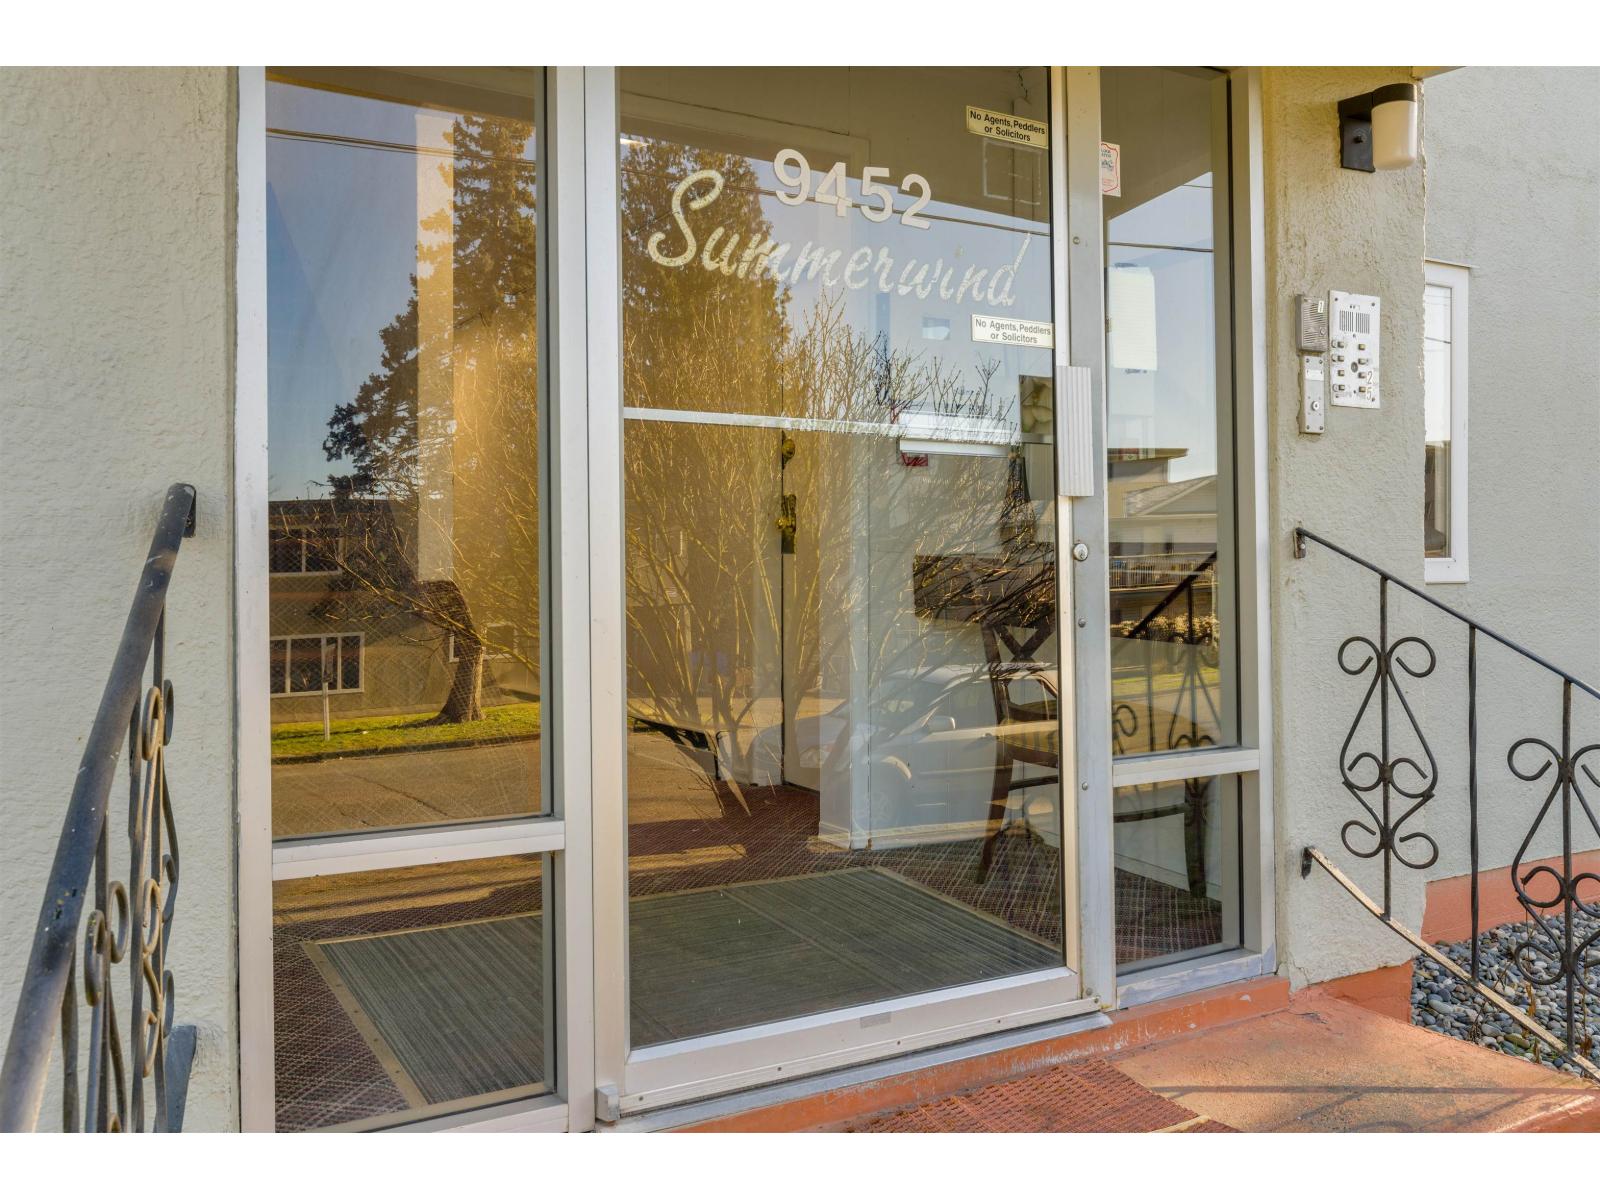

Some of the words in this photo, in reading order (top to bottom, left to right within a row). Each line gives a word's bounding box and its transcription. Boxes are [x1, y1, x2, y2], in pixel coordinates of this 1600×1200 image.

[970, 110, 981, 120] No
[984, 114, 1013, 128] Agents,
[1013, 120, 1046, 134] Peddlers
[996, 126, 1031, 141] Solicitors
[773, 148, 932, 230] 9452
[647, 169, 1033, 307] Summerwind
[976, 318, 986, 328] No
[990, 320, 1018, 333] Agents,
[1020, 324, 1051, 336] Peddlers
[1002, 332, 1038, 344] Solicitors
